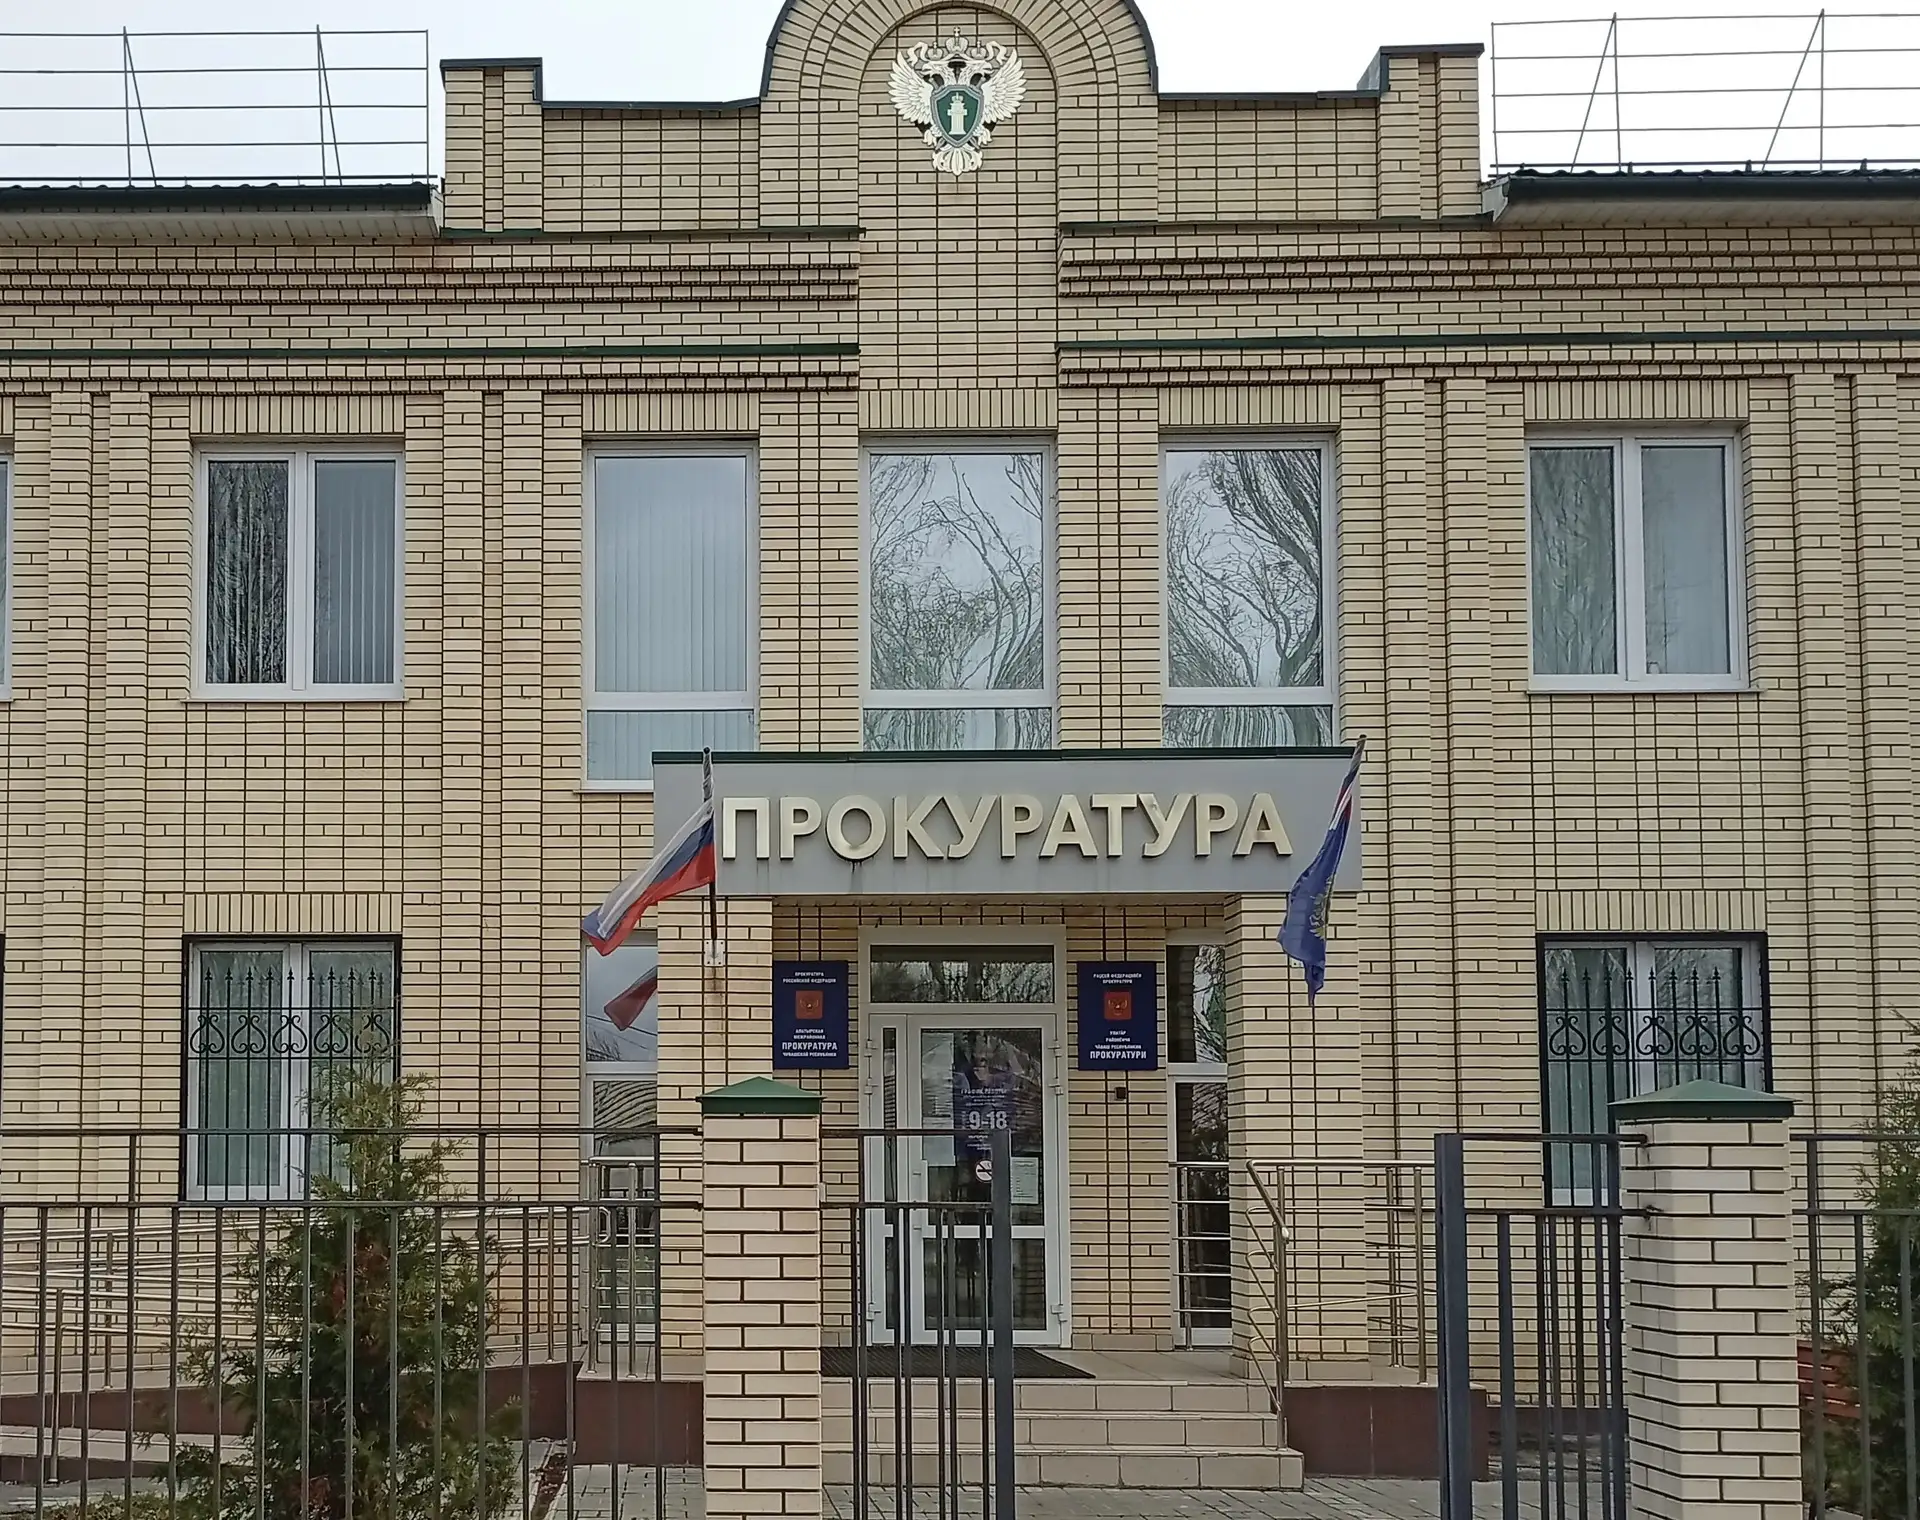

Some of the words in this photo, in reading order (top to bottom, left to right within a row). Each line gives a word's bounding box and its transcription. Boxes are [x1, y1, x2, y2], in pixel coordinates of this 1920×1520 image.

[720, 792, 1293, 861] ПРОКУРАТУРА
[782, 1042, 838, 1050] ПРОКУРАТУРА
[1090, 1050, 1146, 1059] ПРОКУРАТУРИ
[968, 1110, 1008, 1130] 9-18
